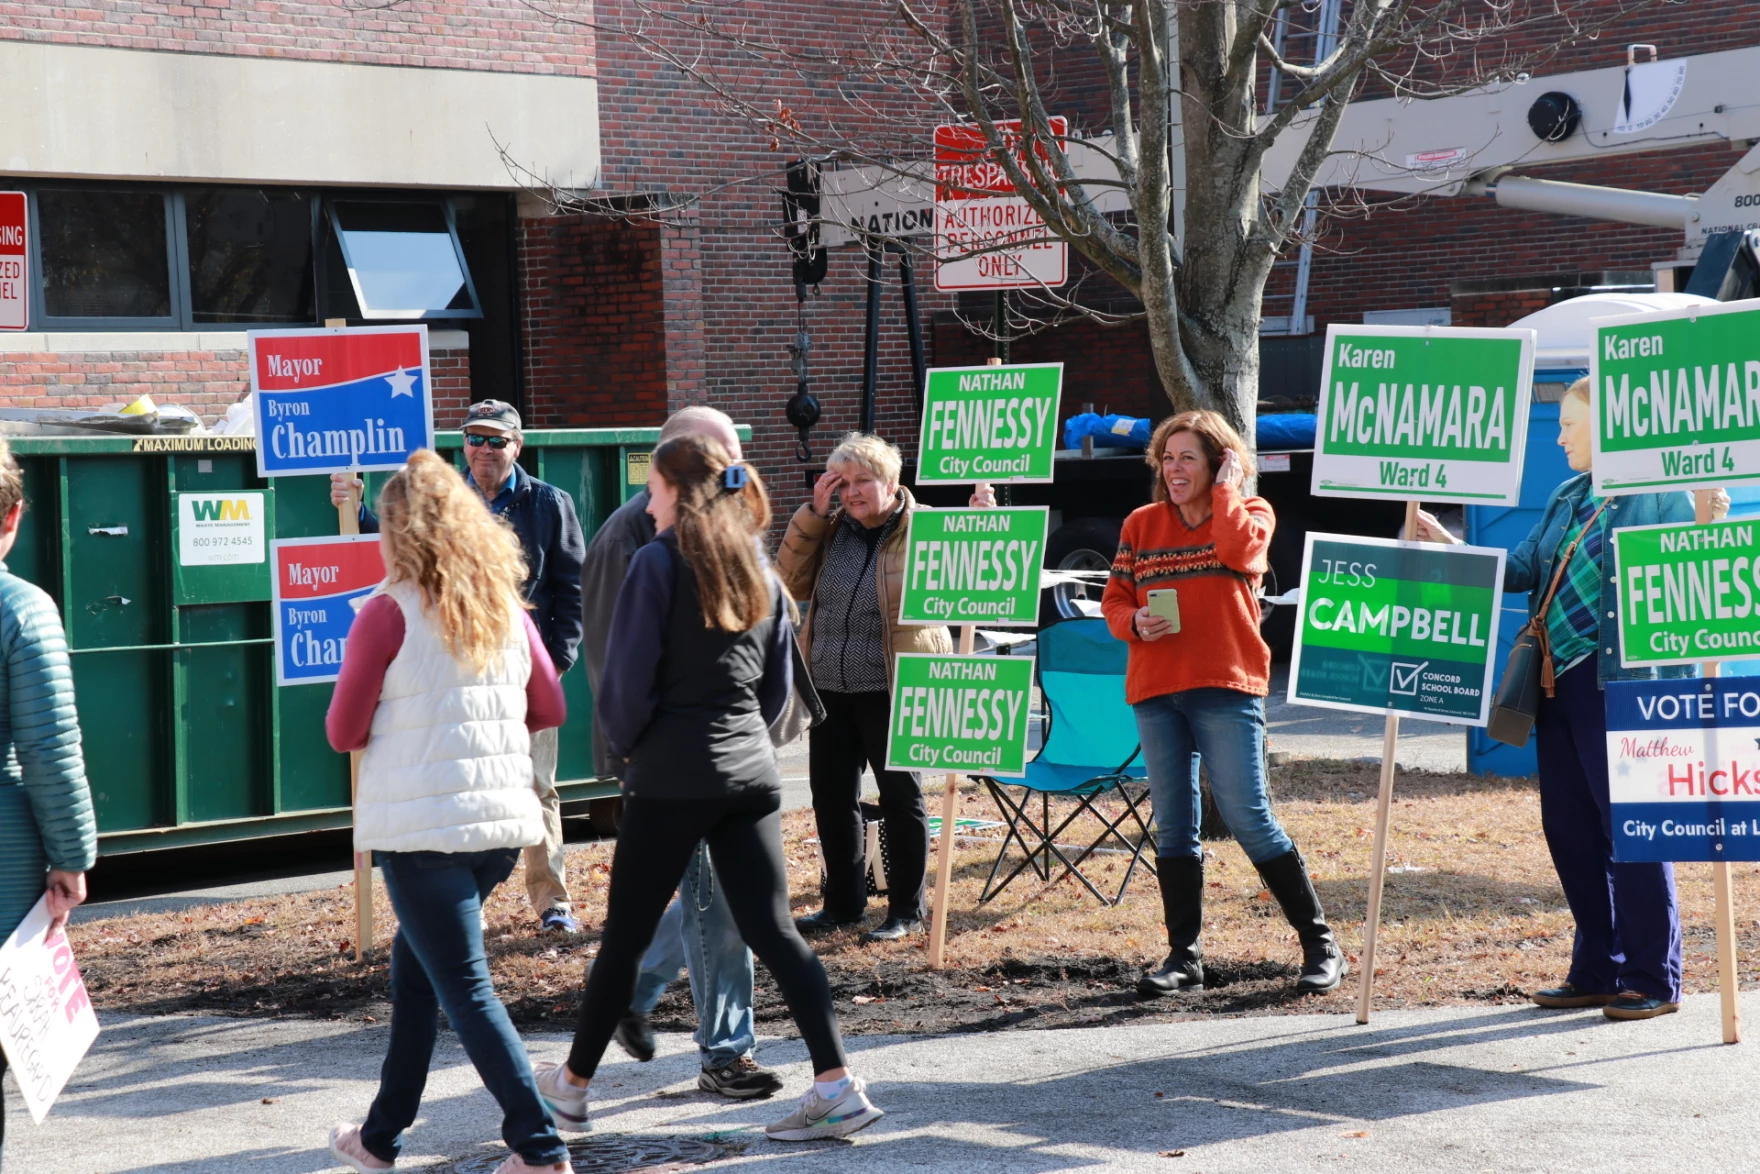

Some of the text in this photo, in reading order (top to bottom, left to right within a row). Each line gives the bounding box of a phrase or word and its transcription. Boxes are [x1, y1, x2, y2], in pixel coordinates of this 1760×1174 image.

[978, 254, 1023, 277] ONLY
[1338, 343, 1396, 369] Karen
[1605, 335, 1664, 361] Karen
[267, 354, 323, 383] Mayor
[959, 372, 1026, 392] NATHAN
[268, 399, 311, 422] Byron
[1330, 381, 1507, 450] McNAMARA
[928, 397, 1052, 450] FENNESSY
[143, 439, 204, 452] MAXIMUM
[271, 418, 407, 466] Champlin
[940, 454, 1031, 478] City Council
[1661, 446, 1735, 476] Ward 4
[1380, 461, 1447, 488] Ward 4
[191, 499, 250, 521] WM
[943, 515, 1011, 532] NATHAN
[193, 536, 253, 547] 800 972 4545
[1660, 525, 1753, 553] NATHAN
[288, 563, 339, 591] Mayor
[911, 540, 1038, 591] FENNESSY
[1318, 559, 1377, 588] JESS
[288, 608, 327, 630] Byron
[923, 597, 1016, 619] City Council
[1308, 597, 1485, 647] CAMPBELL
[1650, 631, 1690, 656] City
[928, 662, 997, 680] NATHAN
[1422, 672, 1461, 683] CONCORD
[1420, 695, 1438, 704] ZONE
[1421, 682, 1480, 697] SCHOOL BOARD
[897, 686, 1023, 741] FENNESSY
[1637, 693, 1715, 720] VOTE
[909, 743, 1002, 766] City Council
[1620, 736, 1695, 759] Matthew
[1623, 820, 1657, 840] City
[1661, 818, 1726, 836] Council
[1731, 821, 1747, 836] at
[44, 975, 60, 1014] FOR
